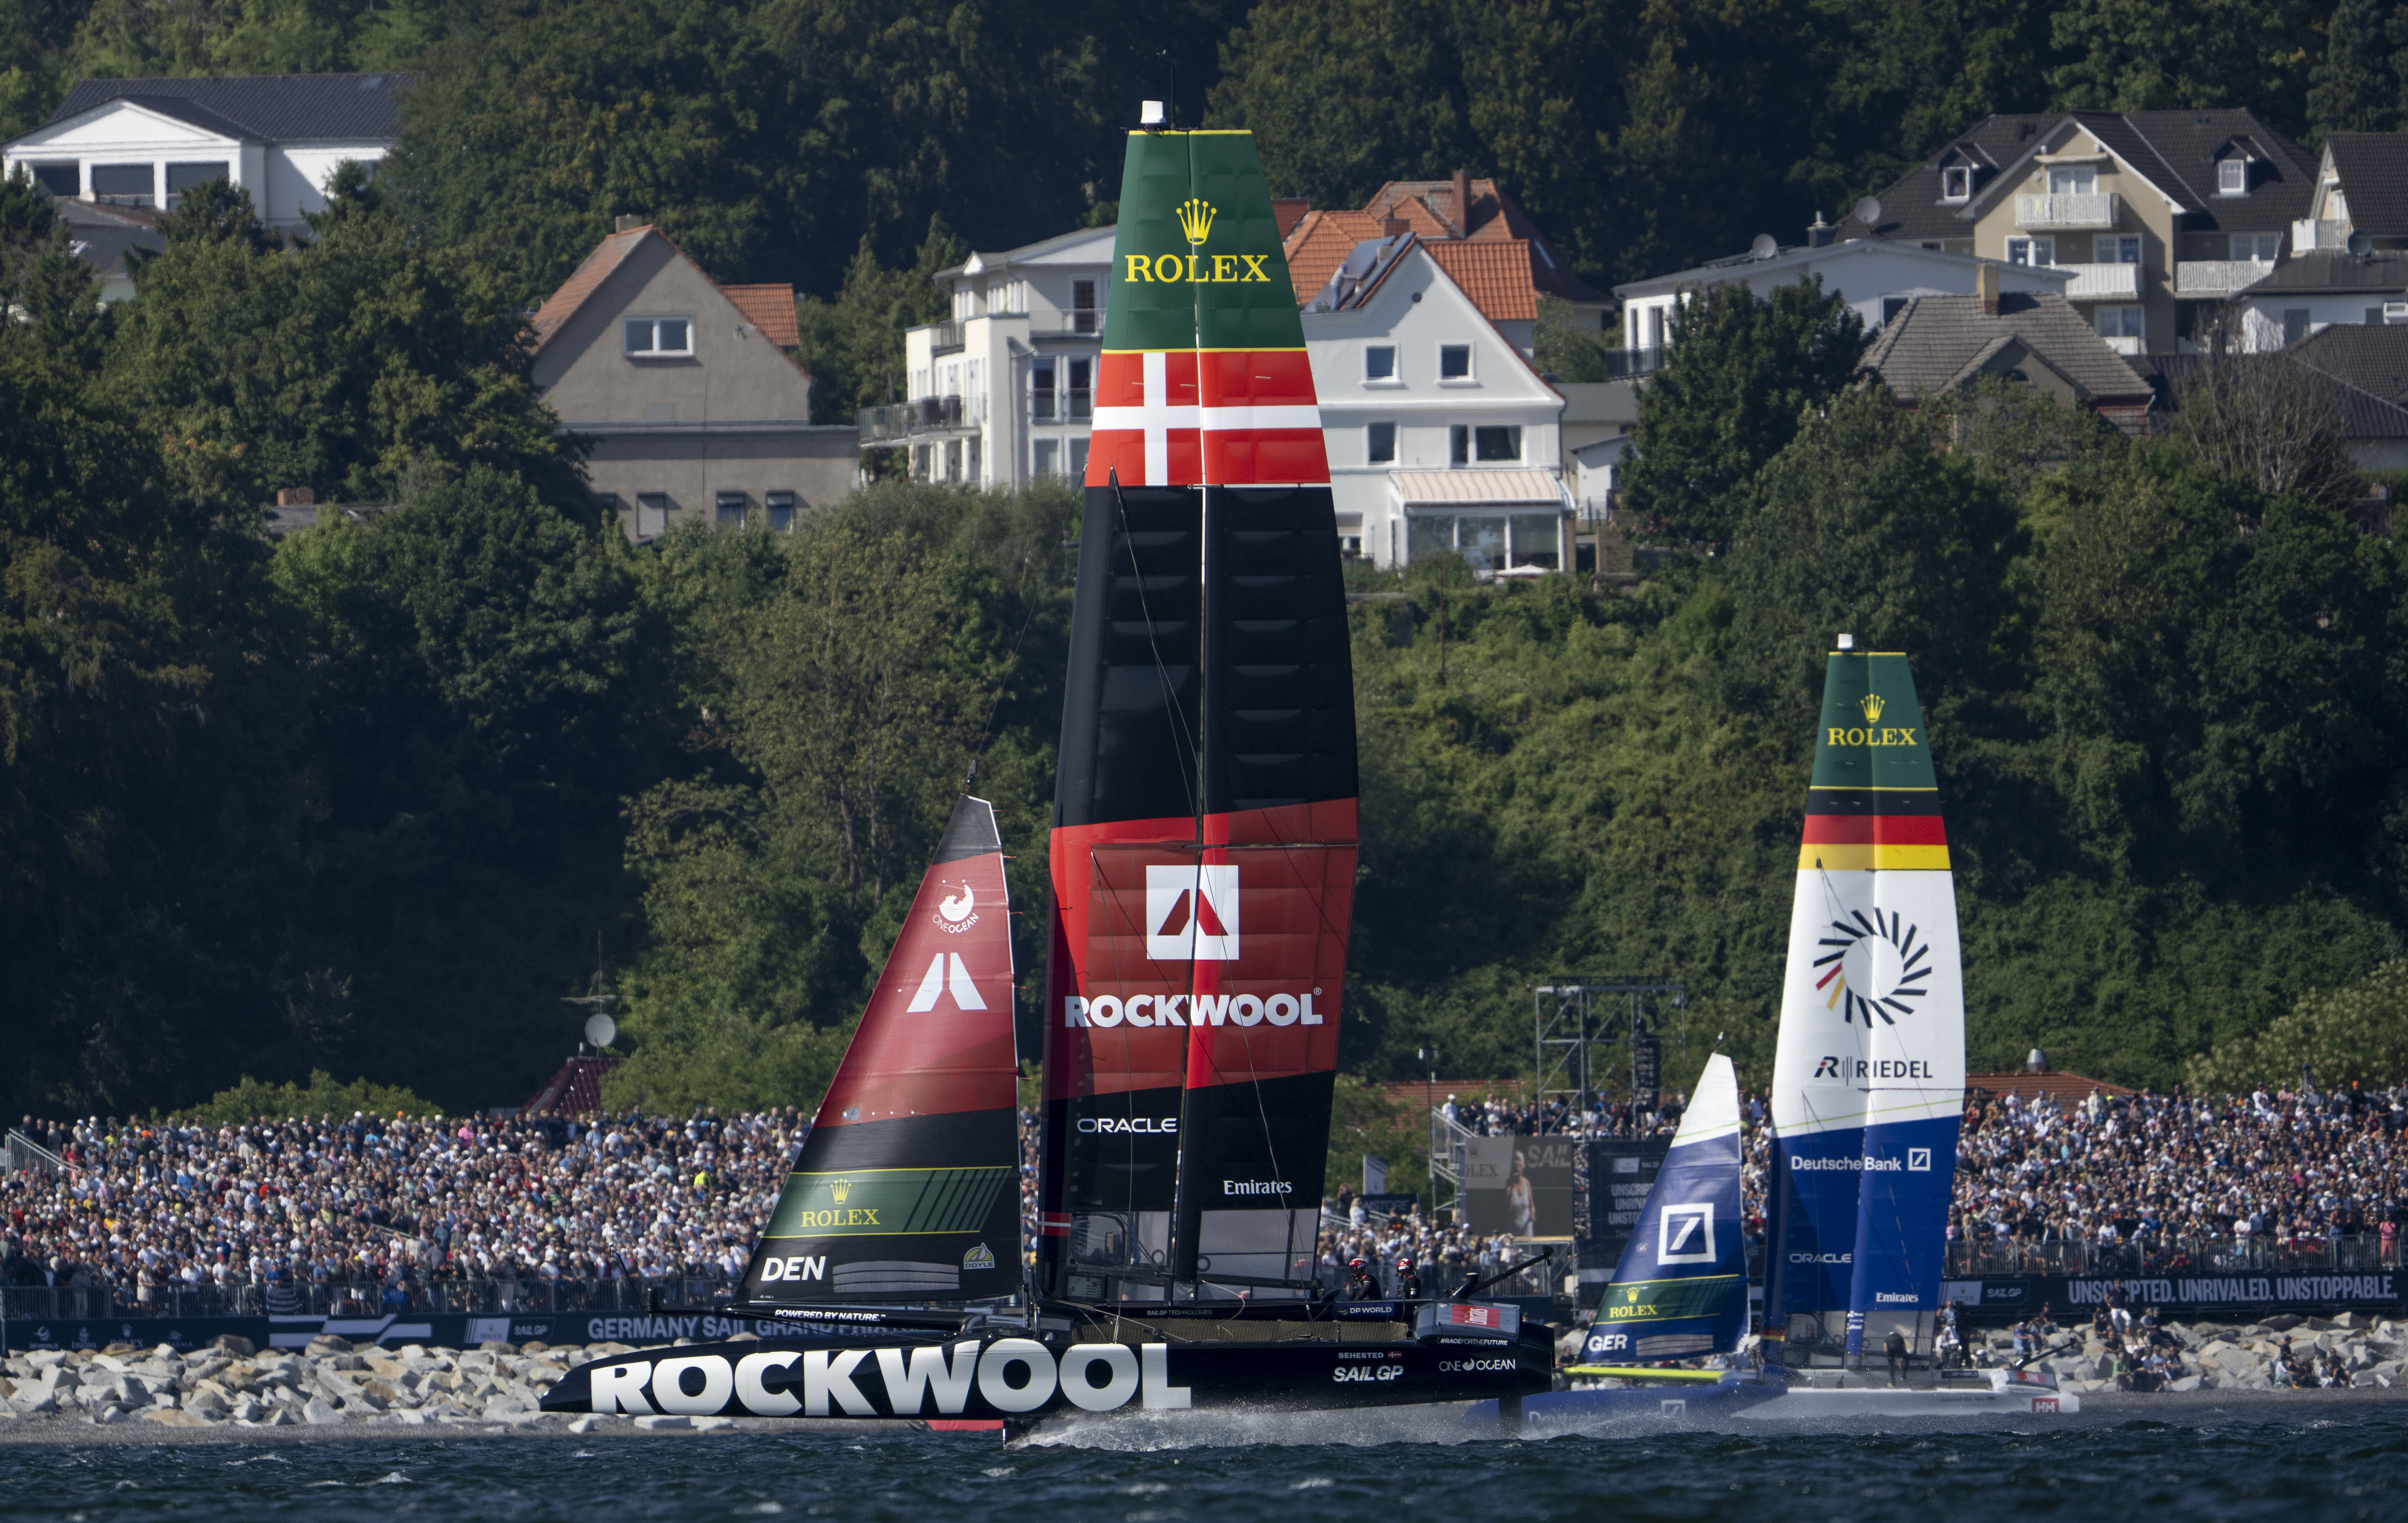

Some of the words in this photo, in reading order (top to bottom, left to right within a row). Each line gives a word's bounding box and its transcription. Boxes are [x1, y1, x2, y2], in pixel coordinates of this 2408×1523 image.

[1125, 254, 1271, 282] ROLEX
[1827, 728, 1918, 746] ROLEX
[1856, 1060, 1933, 1079] RIEDEL
[1077, 1118, 1178, 1133] ORACLE
[1526, 1144, 1572, 1168] SAIL
[1791, 1156, 1862, 1171] Deutsche
[1864, 1156, 1902, 1171] Bank
[1224, 1180, 1292, 1195] Emirates
[801, 1209, 880, 1227] ROLEX
[1789, 1253, 1852, 1264] ORACLE
[761, 1256, 826, 1282] DEN
[1875, 1292, 1919, 1303] Emirates
[1987, 1288, 2007, 1298] SAIL
[2008, 1288, 2022, 1298] GP
[2068, 1279, 2176, 1304] UNSCIPTED.
[2178, 1278, 2275, 1302] UNRIVALED.
[2276, 1274, 2398, 1301] UNSTOPPABLE.
[775, 1309, 822, 1319] POWERED
[824, 1311, 839, 1320] BY
[1609, 1304, 1658, 1319] ROLEX
[514, 1325, 533, 1335] SAIL
[534, 1325, 548, 1335] GP
[587, 1316, 699, 1339] GERMANY
[702, 1315, 746, 1337] SAIL
[1588, 1334, 1628, 1352] GER
[1333, 1366, 1375, 1382] SAIL
[1377, 1365, 1404, 1381] GP
[1439, 1361, 1461, 1371] ONE
[1476, 1359, 1515, 1370] OCEAN
[591, 1338, 1191, 1416] ROCKWOOL
